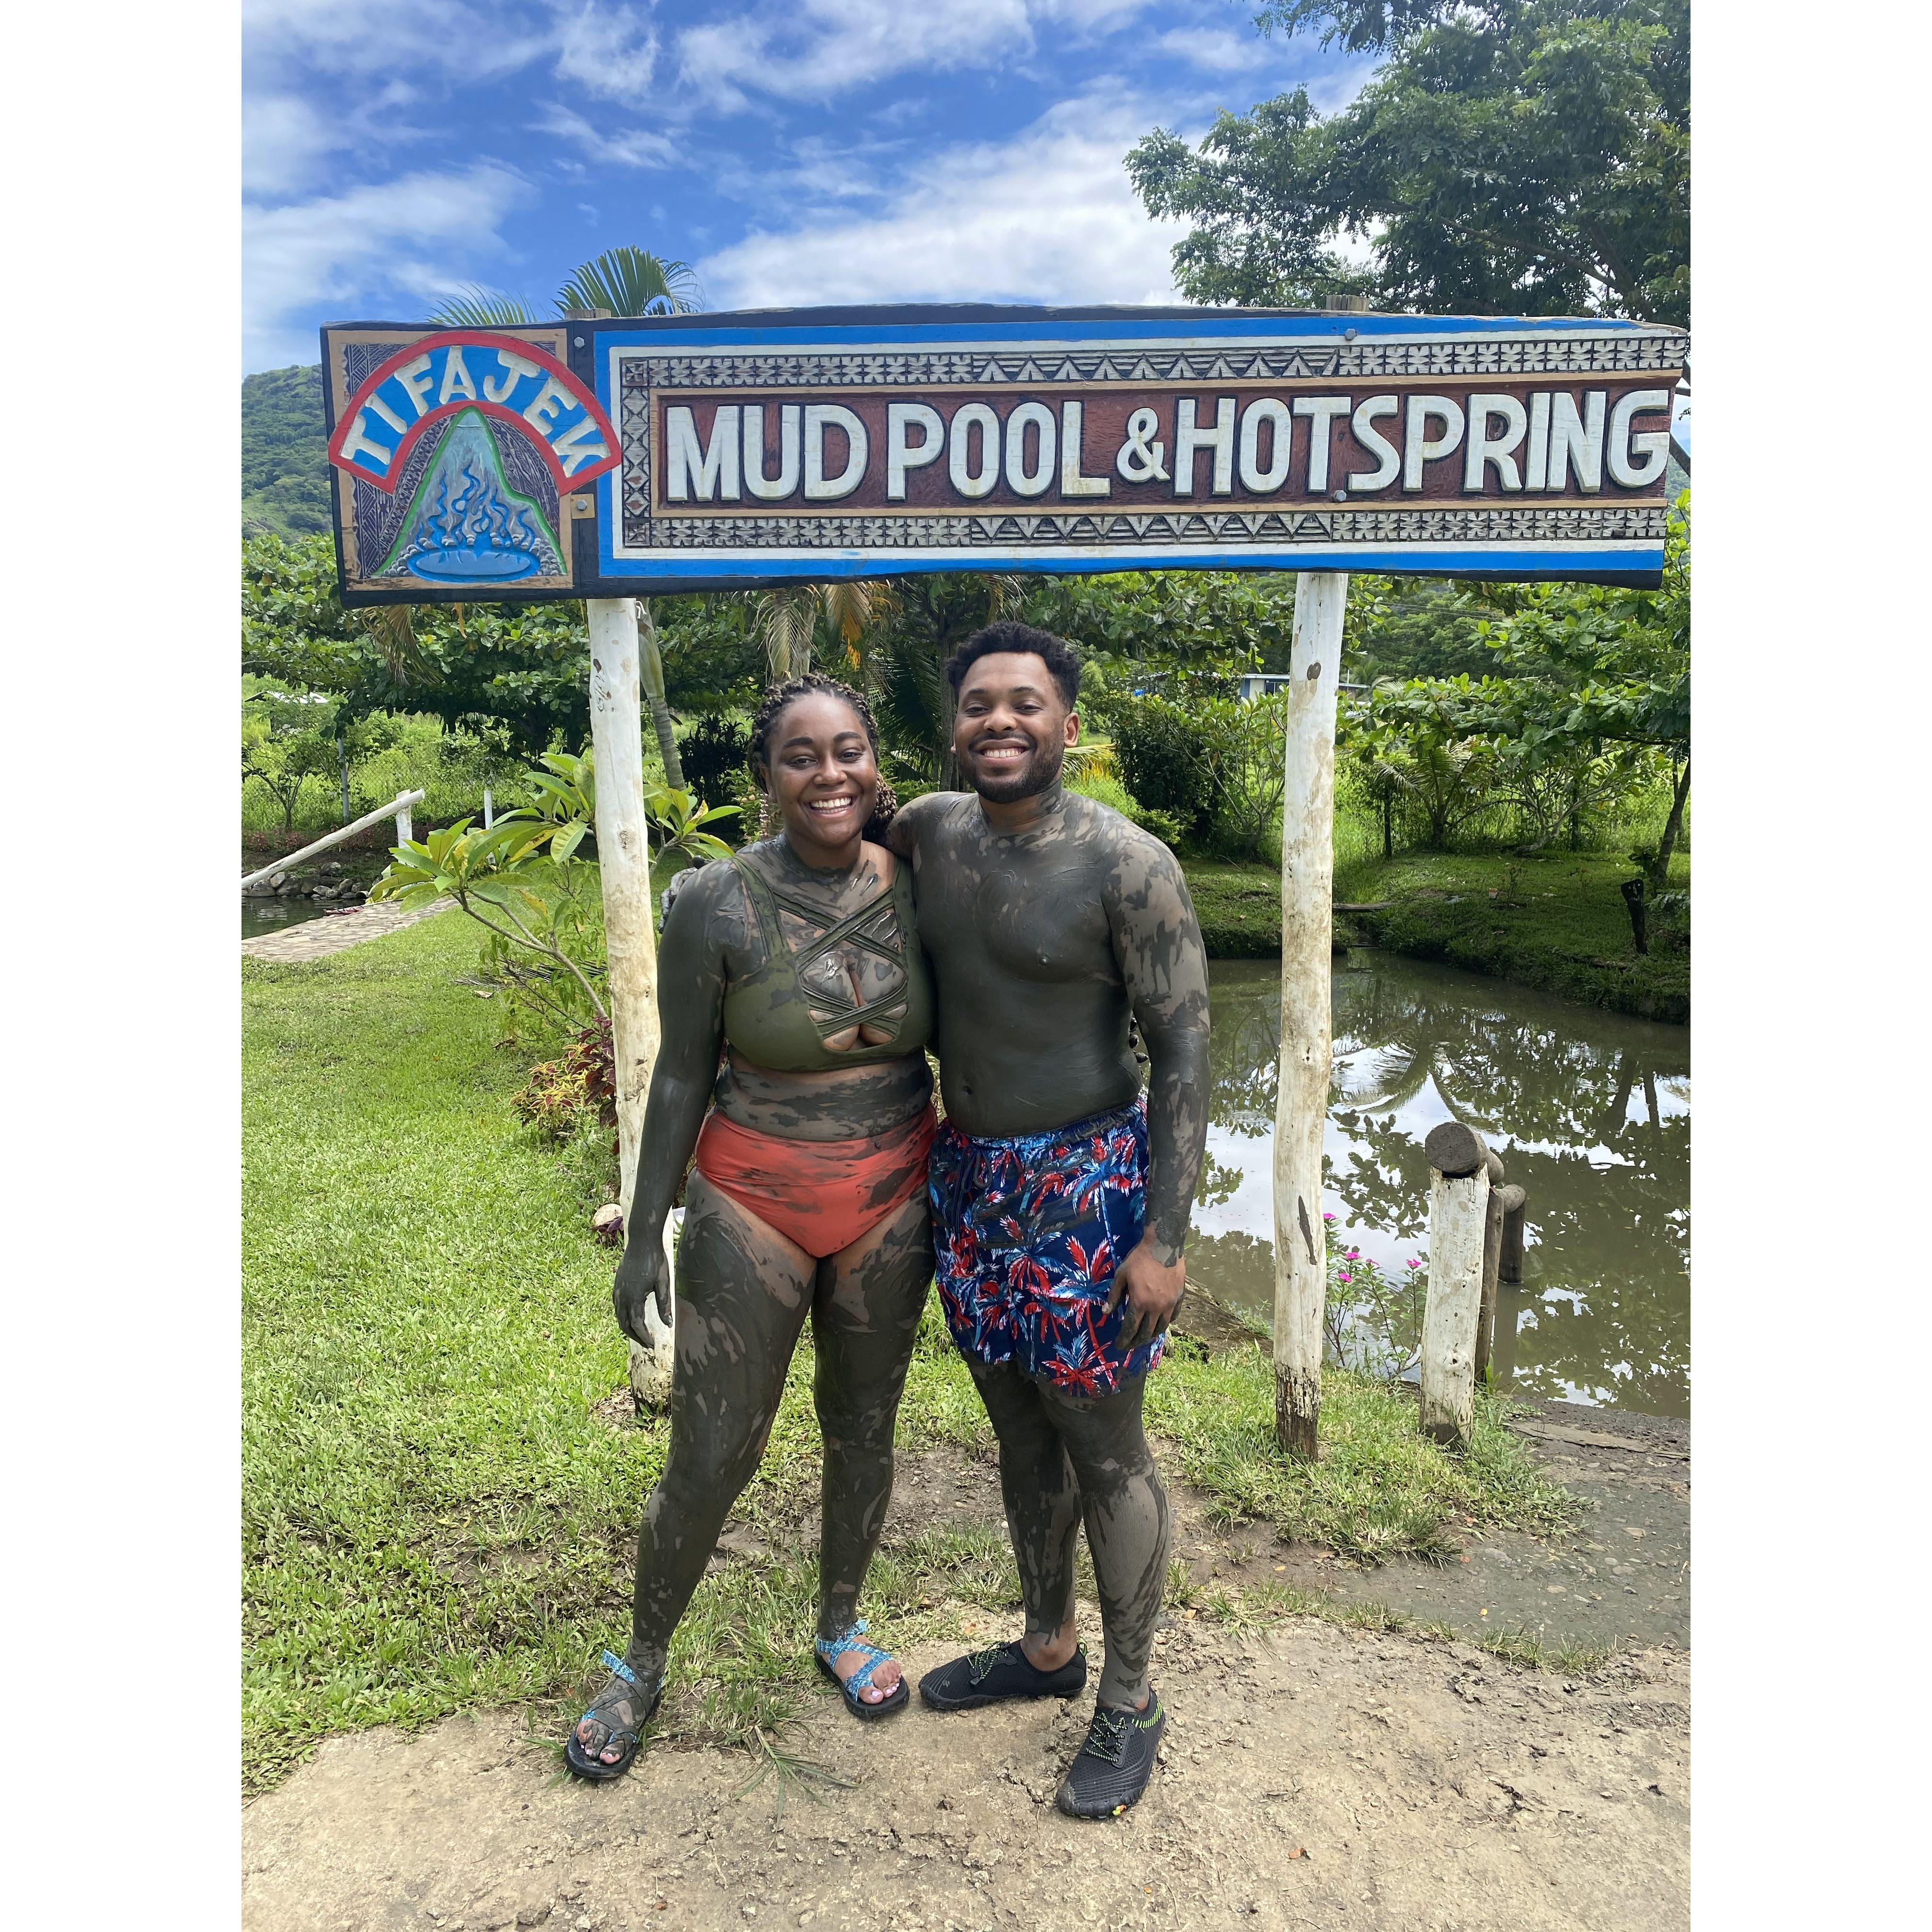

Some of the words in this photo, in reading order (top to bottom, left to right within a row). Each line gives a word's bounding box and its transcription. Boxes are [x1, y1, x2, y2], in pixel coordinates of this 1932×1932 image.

[341, 345, 610, 477] TIFAJEK
[667, 404, 868, 502] MUD
[887, 401, 1111, 501] POOL
[1116, 407, 1170, 482] &
